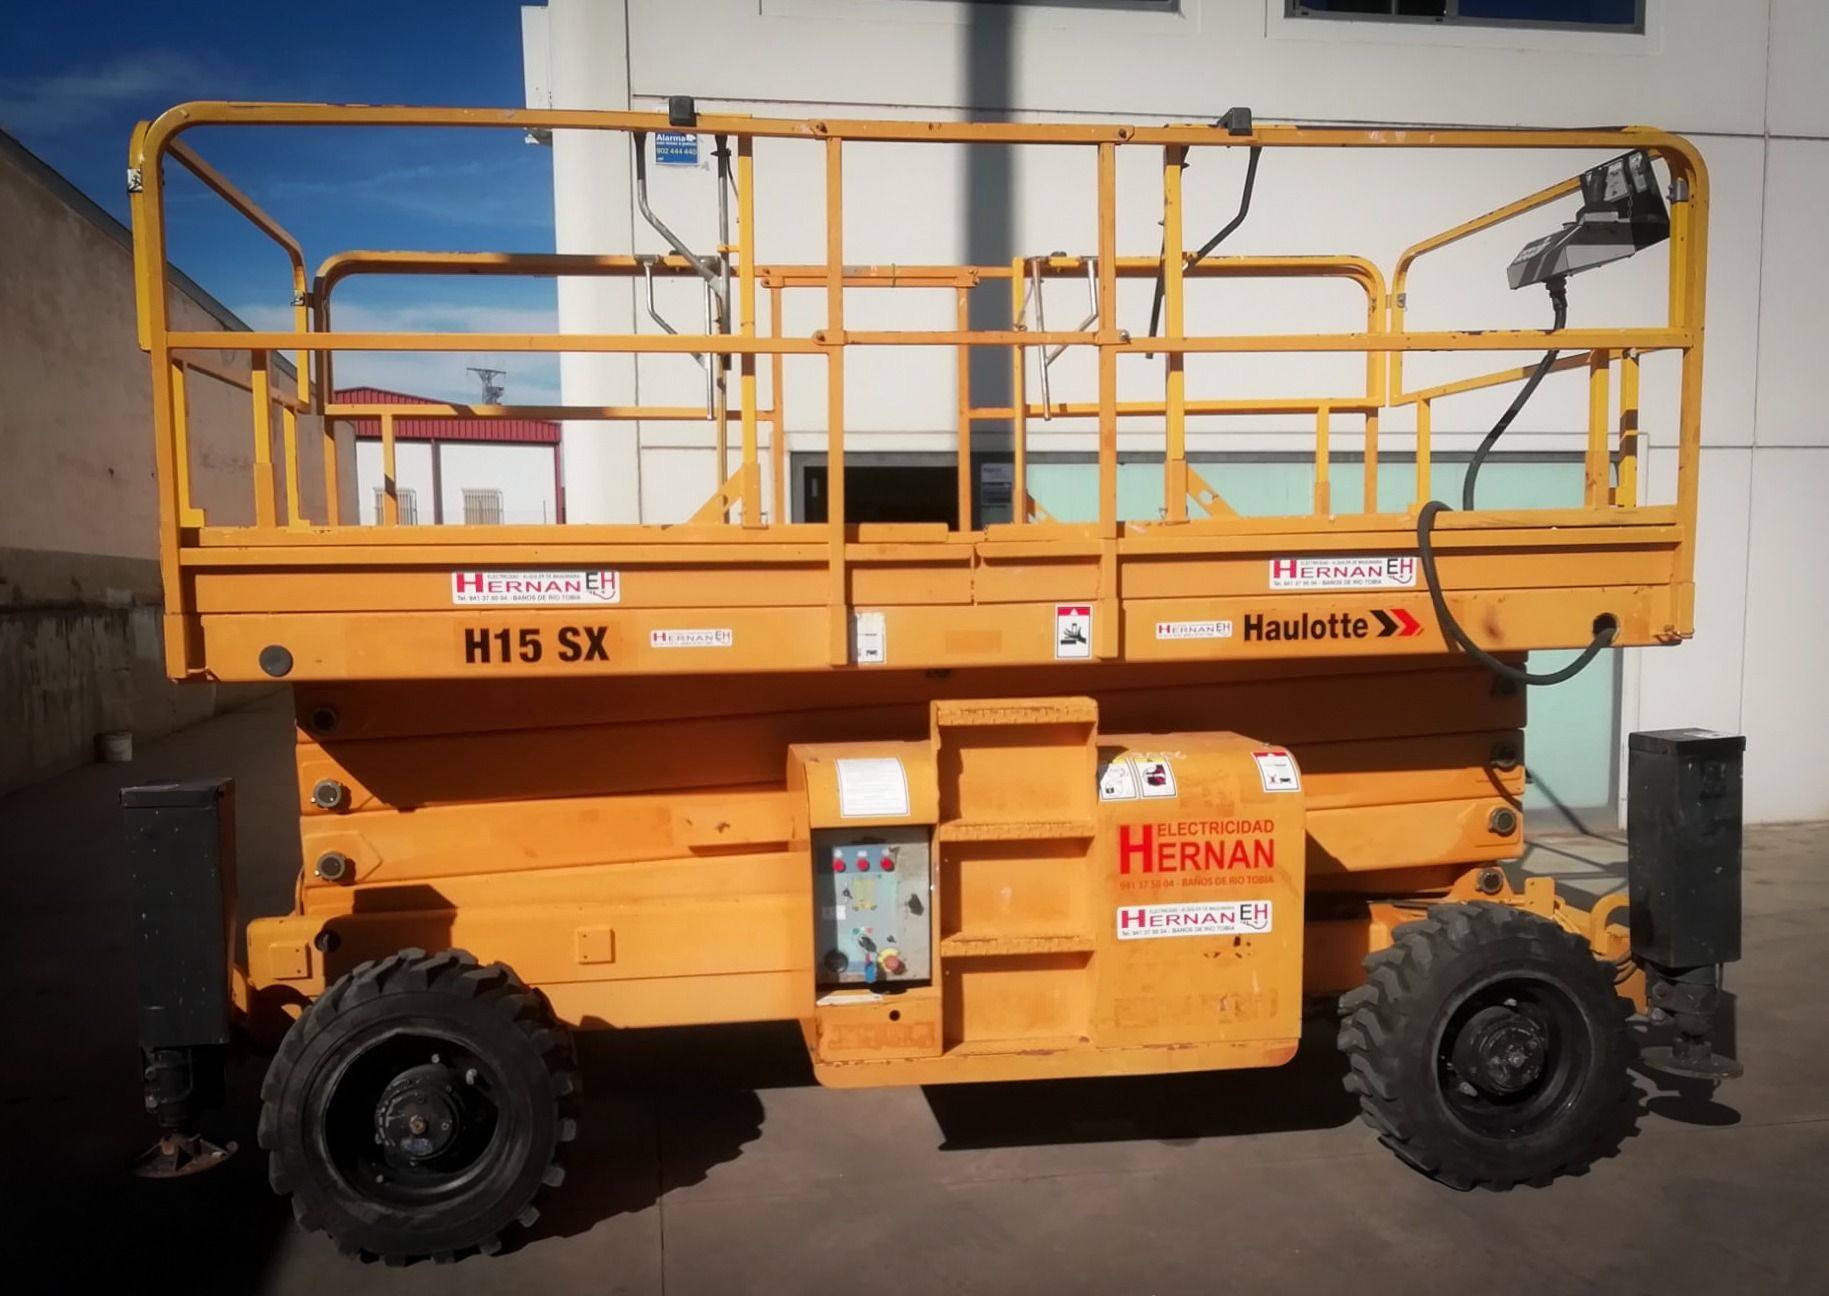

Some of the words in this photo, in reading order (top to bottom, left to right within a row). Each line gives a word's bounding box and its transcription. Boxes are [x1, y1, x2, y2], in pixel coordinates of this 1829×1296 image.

[656, 133, 686, 142] Alarma
[1273, 559, 1382, 578] HERNAN
[1387, 558, 1413, 575] EH
[456, 571, 581, 593] HERNAN
[585, 571, 616, 590] EH
[1158, 624, 1214, 634] HERNAN
[1244, 612, 1368, 641] Haulotte
[464, 627, 543, 664] H15
[557, 626, 609, 663] SX
[653, 631, 714, 642] HERNAN
[1157, 819, 1275, 837] ELECTRICIDAD
[1120, 824, 1275, 874] HERNAN
[1162, 879, 1174, 888] 04
[1215, 877, 1227, 886] DE
[1121, 909, 1235, 928] HERNAN
[1240, 903, 1268, 920] EH
